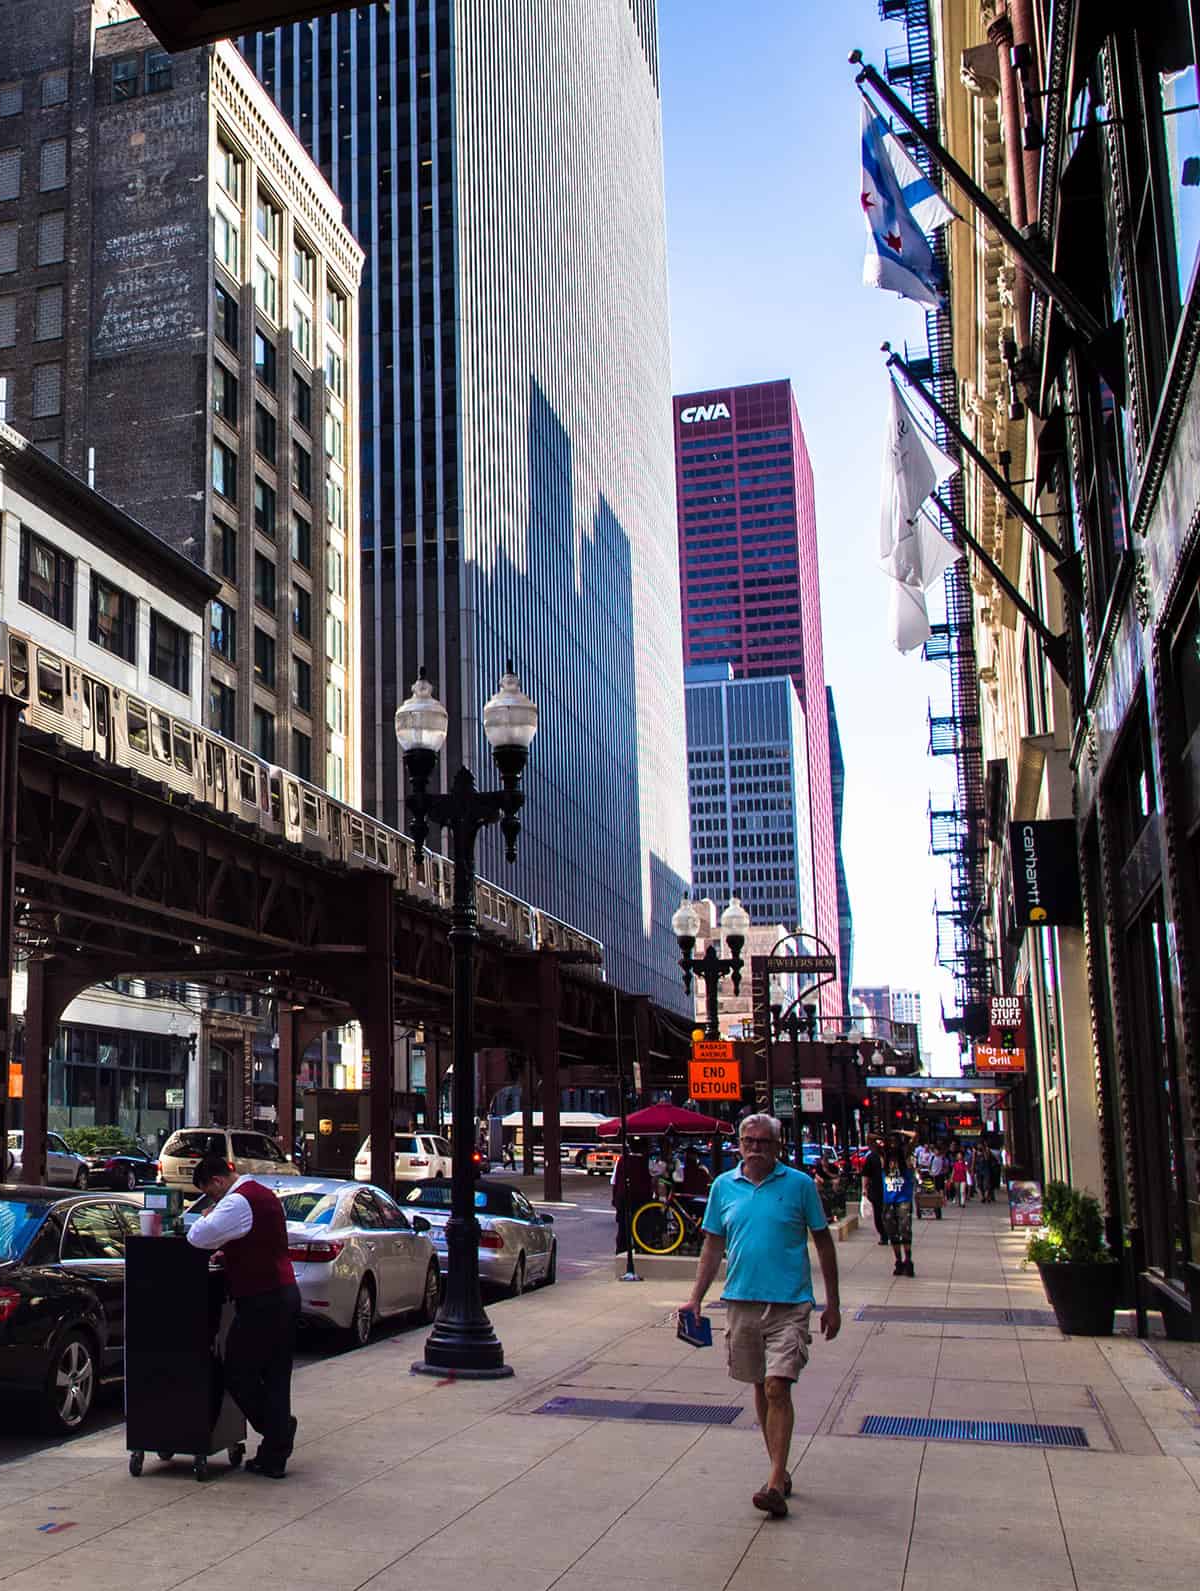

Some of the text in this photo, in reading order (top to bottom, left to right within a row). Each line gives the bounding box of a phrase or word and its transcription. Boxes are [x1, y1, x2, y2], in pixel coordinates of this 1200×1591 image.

[679, 402, 731, 424] CNA
[1023, 825, 1041, 905] carhartt
[991, 997, 1020, 1009] GOOD
[752, 970, 768, 1059] AVENUE
[991, 1008, 1022, 1019] STUFF
[991, 1019, 1022, 1027] EATERY
[988, 1056, 1012, 1065] Grill
[703, 1066, 726, 1079] END
[692, 1081, 738, 1094] DETOUR
